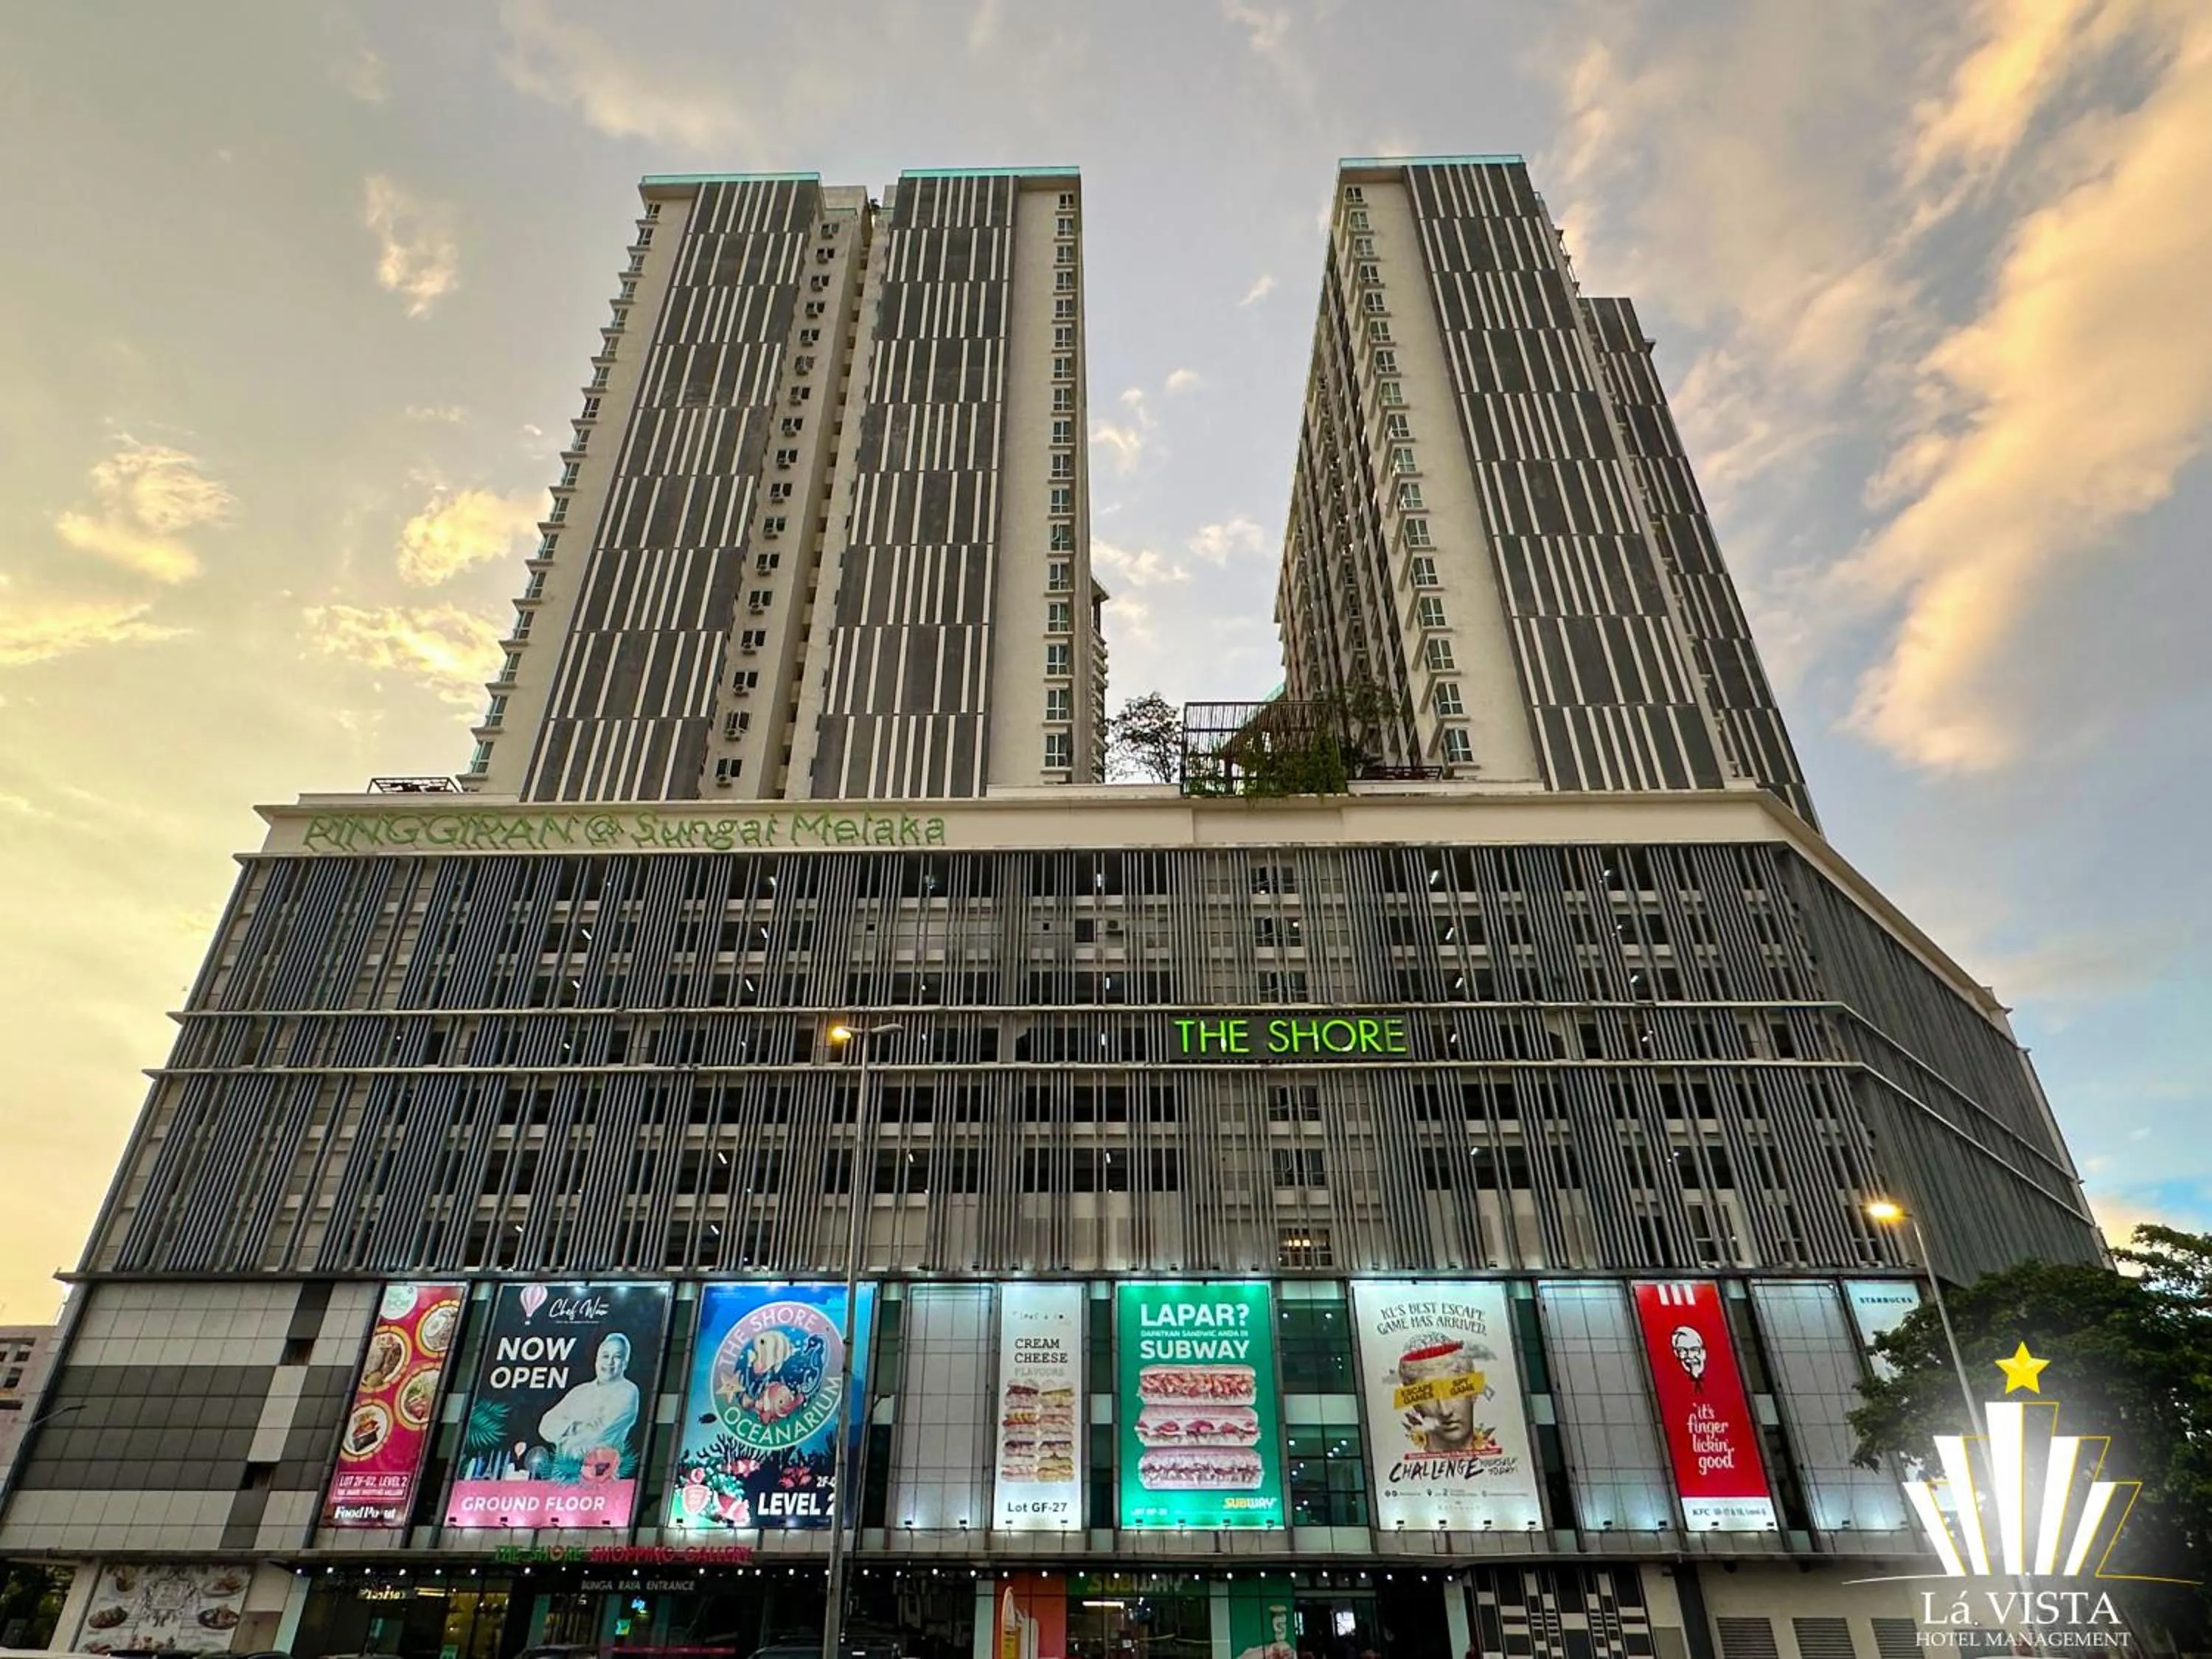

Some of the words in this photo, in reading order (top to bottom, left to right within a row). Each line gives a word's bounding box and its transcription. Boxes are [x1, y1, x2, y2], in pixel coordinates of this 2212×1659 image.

[630, 812, 777, 850] Sungai
[791, 810, 945, 846] Melaka
[1174, 1020, 1250, 1053] THE
[1267, 1019, 1407, 1053] SHORE
[1140, 1303, 1250, 1326] LAPAR?
[1380, 1303, 1406, 1320] KL'S
[1408, 1302, 1436, 1315] BEST
[1441, 1302, 1486, 1322] ESCAPE
[1377, 1318, 1409, 1335] GAME
[1411, 1315, 1433, 1327] HAS
[718, 1330, 747, 1368] THE
[750, 1307, 818, 1332] SHORE
[1015, 1338, 1060, 1349] CREAM
[496, 1336, 577, 1361] NOW
[1015, 1352, 1068, 1363] CHEESE
[1140, 1340, 1250, 1359] SUBWAY
[490, 1366, 569, 1389] OPEN
[724, 1377, 842, 1444] OCEANARIUM
[1686, 1413, 1729, 1439] finger
[1389, 1458, 1484, 1483] CHALLENGE
[340, 1476, 354, 1486] LOT
[379, 1476, 400, 1486] LEVEL
[400, 1476, 408, 1486] 2
[335, 1506, 364, 1519] Food
[461, 1496, 539, 1512] GROUND
[544, 1496, 606, 1512] FLOOR
[757, 1492, 821, 1515] LEVEL
[1008, 1503, 1027, 1512] Lot
[1032, 1502, 1067, 1512] GF-27
[1224, 1498, 1276, 1509] SUBWAY
[529, 1545, 582, 1562] SHORE
[591, 1545, 674, 1562] SHOPPING
[684, 1545, 753, 1562] GALLERY
[581, 1580, 613, 1591] BUNGA
[618, 1580, 641, 1591] RAYA
[646, 1580, 695, 1591] ENTRANCE
[1087, 1572, 1188, 1593] SUBWAY
